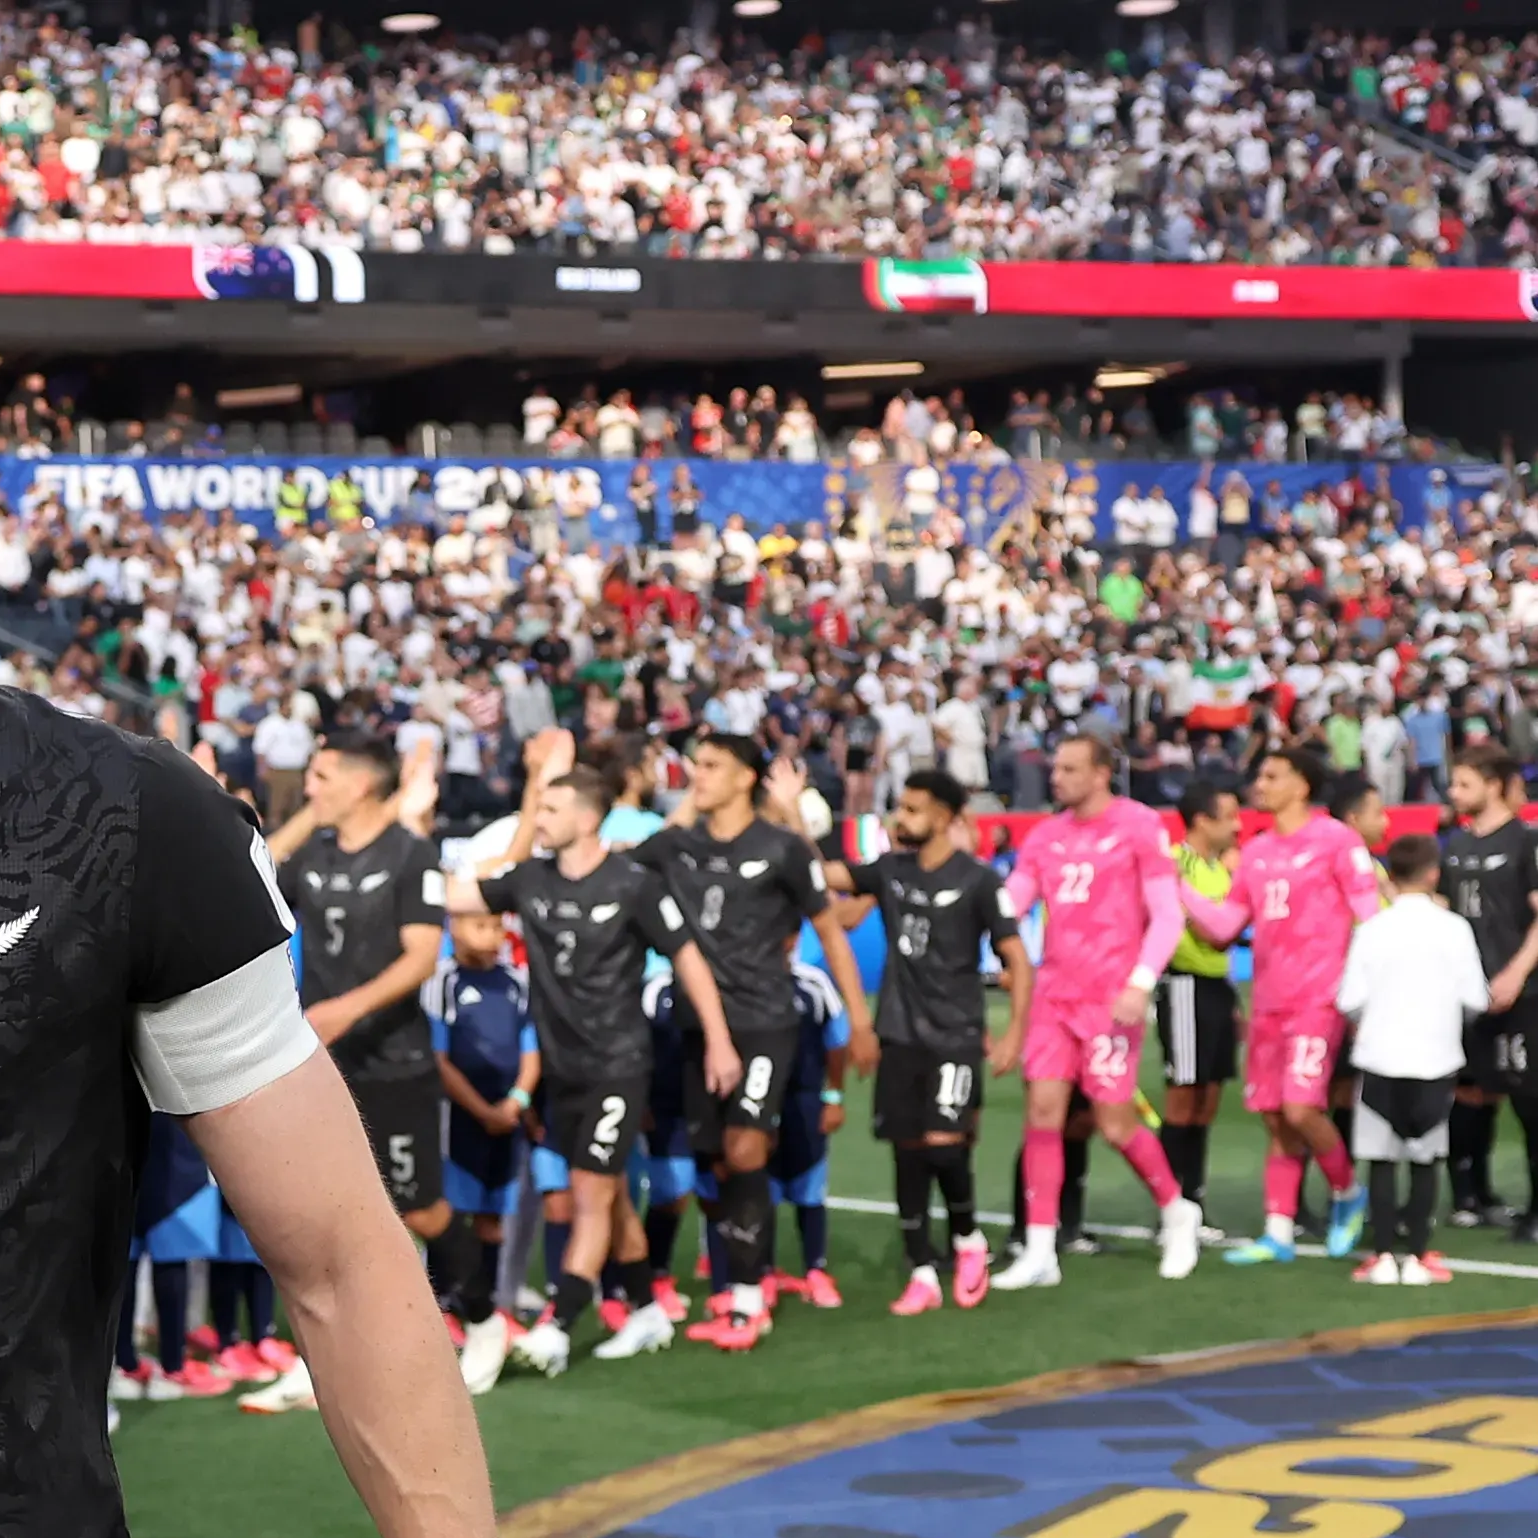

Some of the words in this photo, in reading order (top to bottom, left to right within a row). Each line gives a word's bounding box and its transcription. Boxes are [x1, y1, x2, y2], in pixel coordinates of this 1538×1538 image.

[1056, 861, 1095, 904] 22
[1089, 1033, 1129, 1077] 22
[1293, 1034, 1328, 1078] 12
[935, 1061, 974, 1107] 10
[593, 1095, 626, 1145] 2
[388, 1133, 416, 1184] 5
